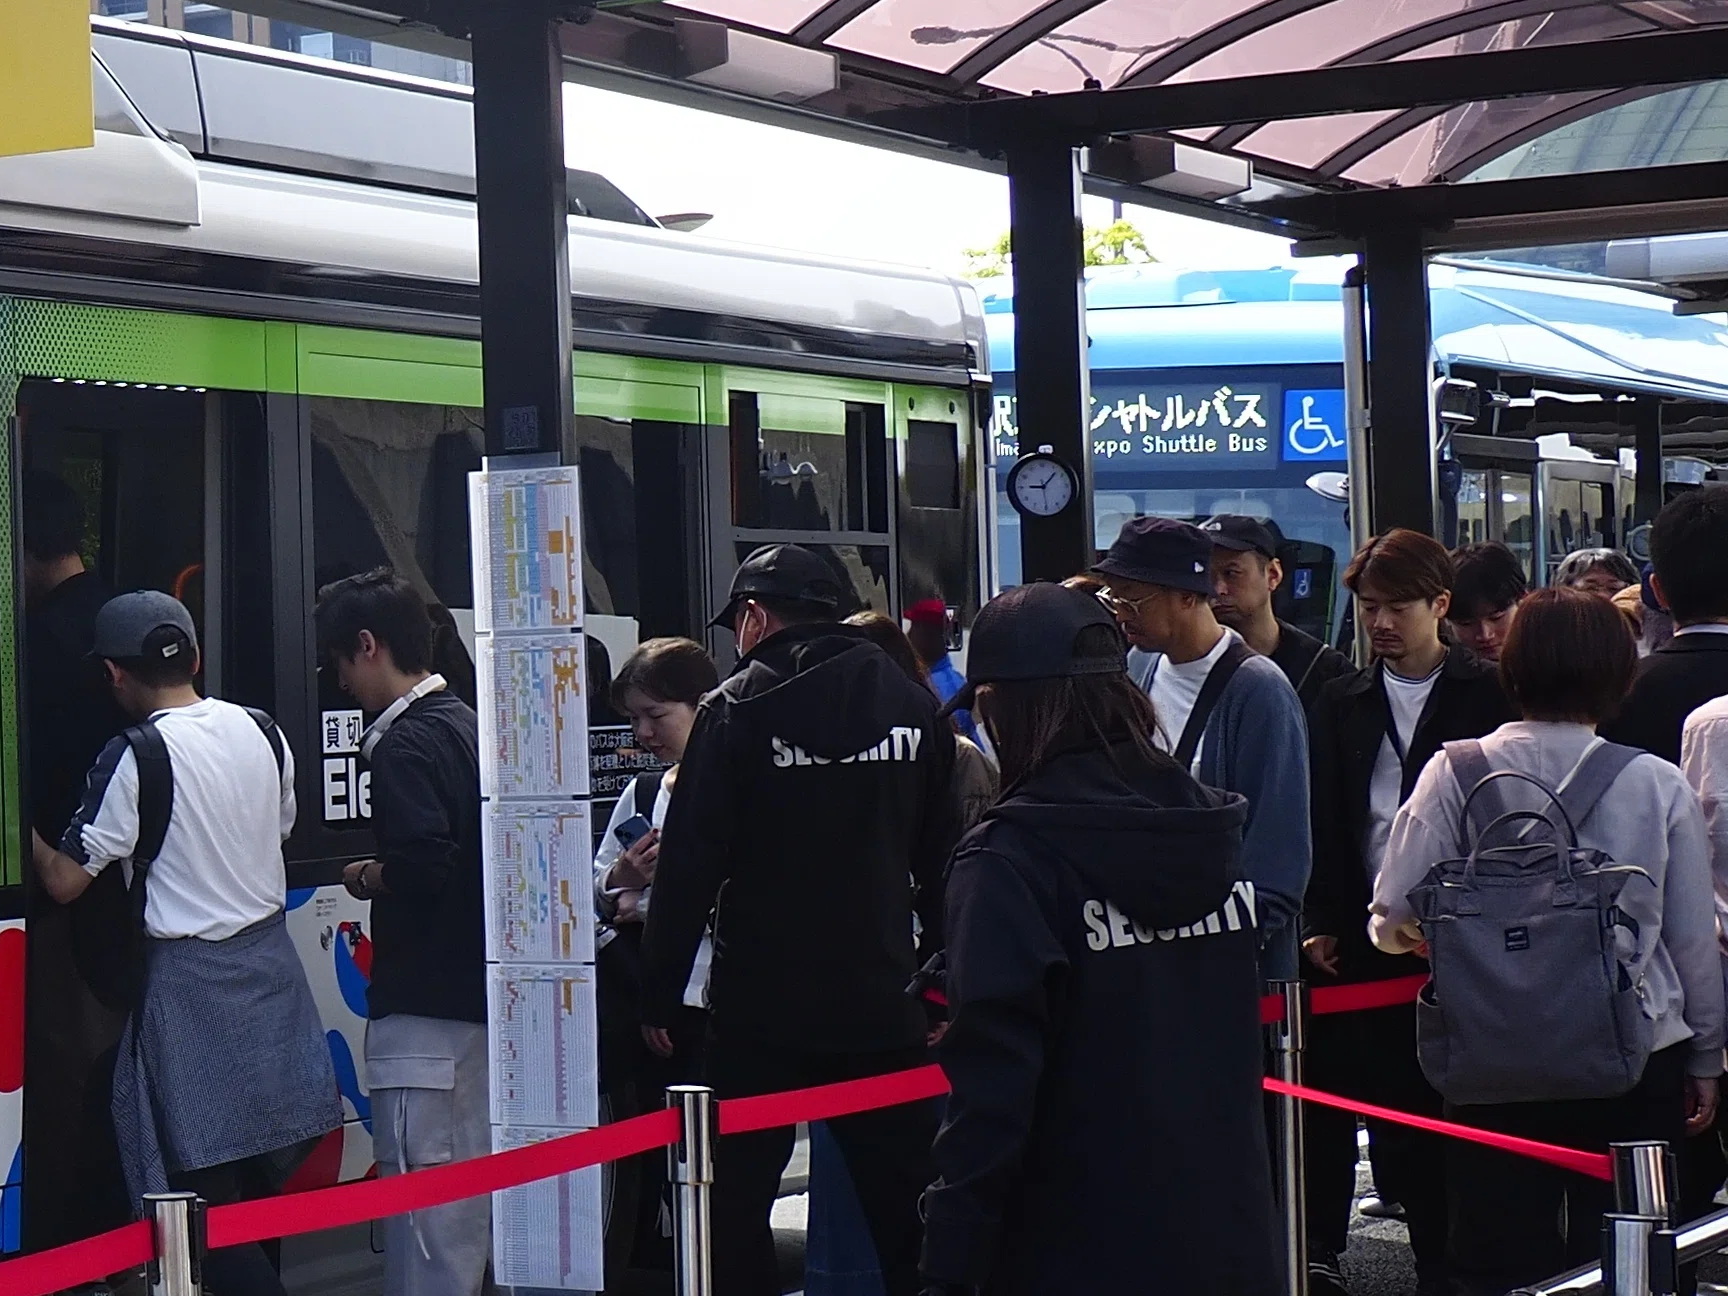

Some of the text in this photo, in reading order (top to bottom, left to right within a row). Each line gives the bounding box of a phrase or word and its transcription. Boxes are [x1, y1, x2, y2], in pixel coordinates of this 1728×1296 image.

[1093, 433, 1268, 459] xpo Shuttle Bus
[325, 715, 361, 748] 貸切
[323, 757, 372, 822] Ele
